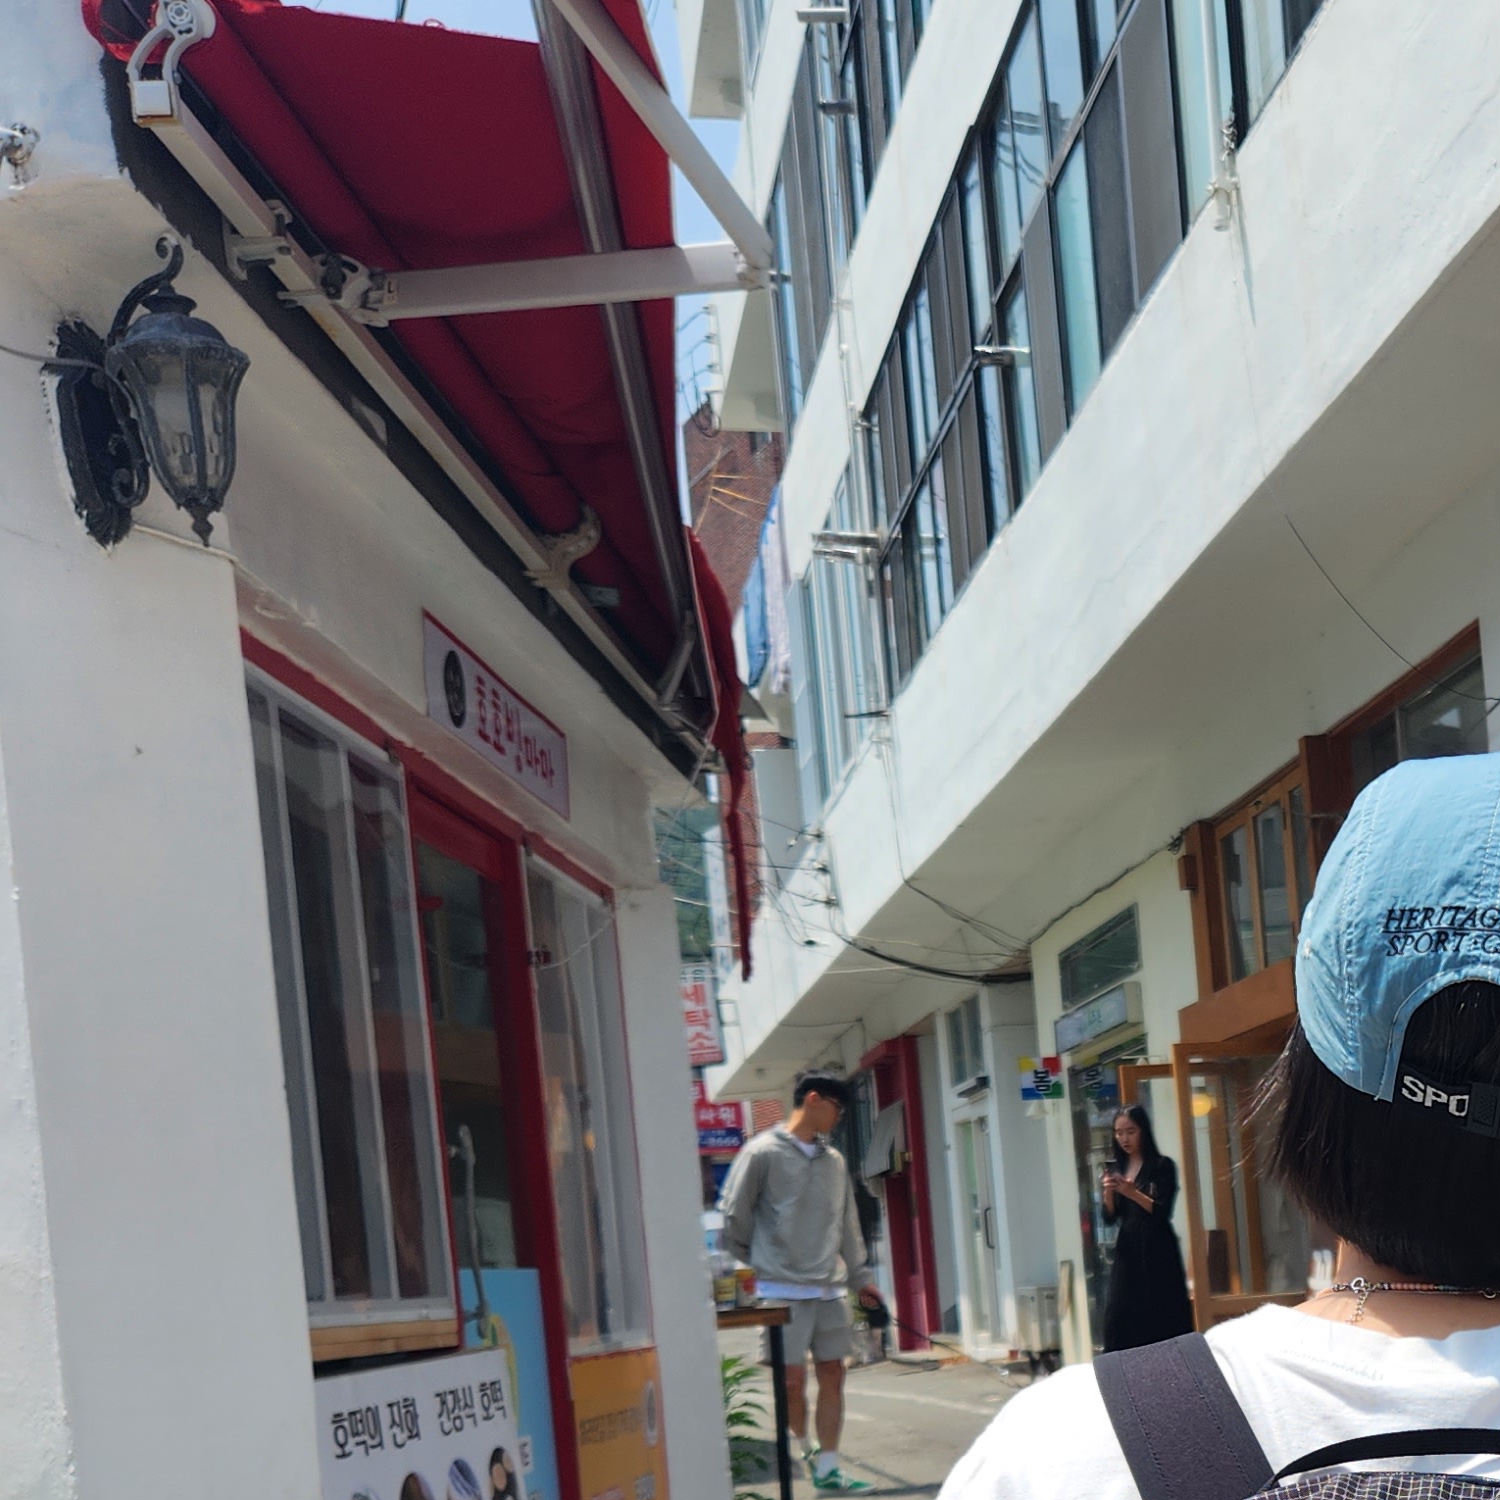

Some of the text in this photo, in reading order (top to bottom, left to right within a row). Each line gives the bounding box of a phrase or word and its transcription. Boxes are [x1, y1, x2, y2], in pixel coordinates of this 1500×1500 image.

[1386, 931, 1468, 957] SPORT
[331, 1379, 508, 1459] 호떡의 진화 건강식 호떡
